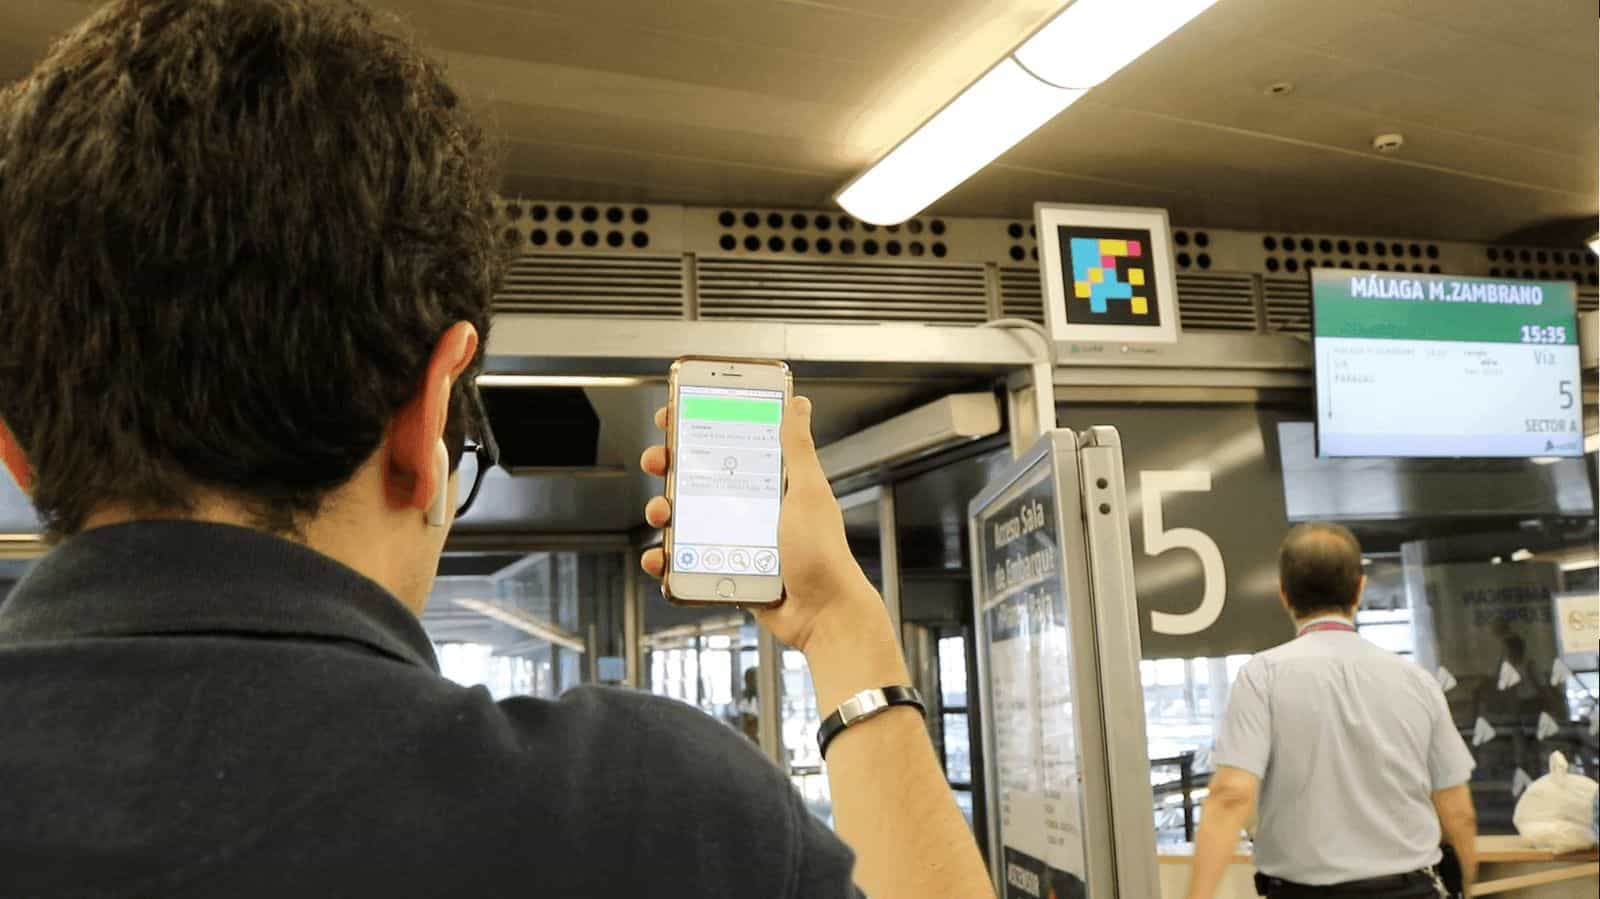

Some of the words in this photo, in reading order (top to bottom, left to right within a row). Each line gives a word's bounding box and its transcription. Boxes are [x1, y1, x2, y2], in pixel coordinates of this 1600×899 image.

[1351, 274, 1424, 300] MÁLAGA
[1429, 283, 1543, 305] M.ZAMBRANO
[1520, 325, 1566, 344] 15:35
[1559, 381, 1574, 410] 5
[1525, 418, 1564, 433] SECTOR
[1566, 419, 1577, 433] A
[1021, 499, 1045, 535] Sala
[1139, 470, 1227, 635] 5
